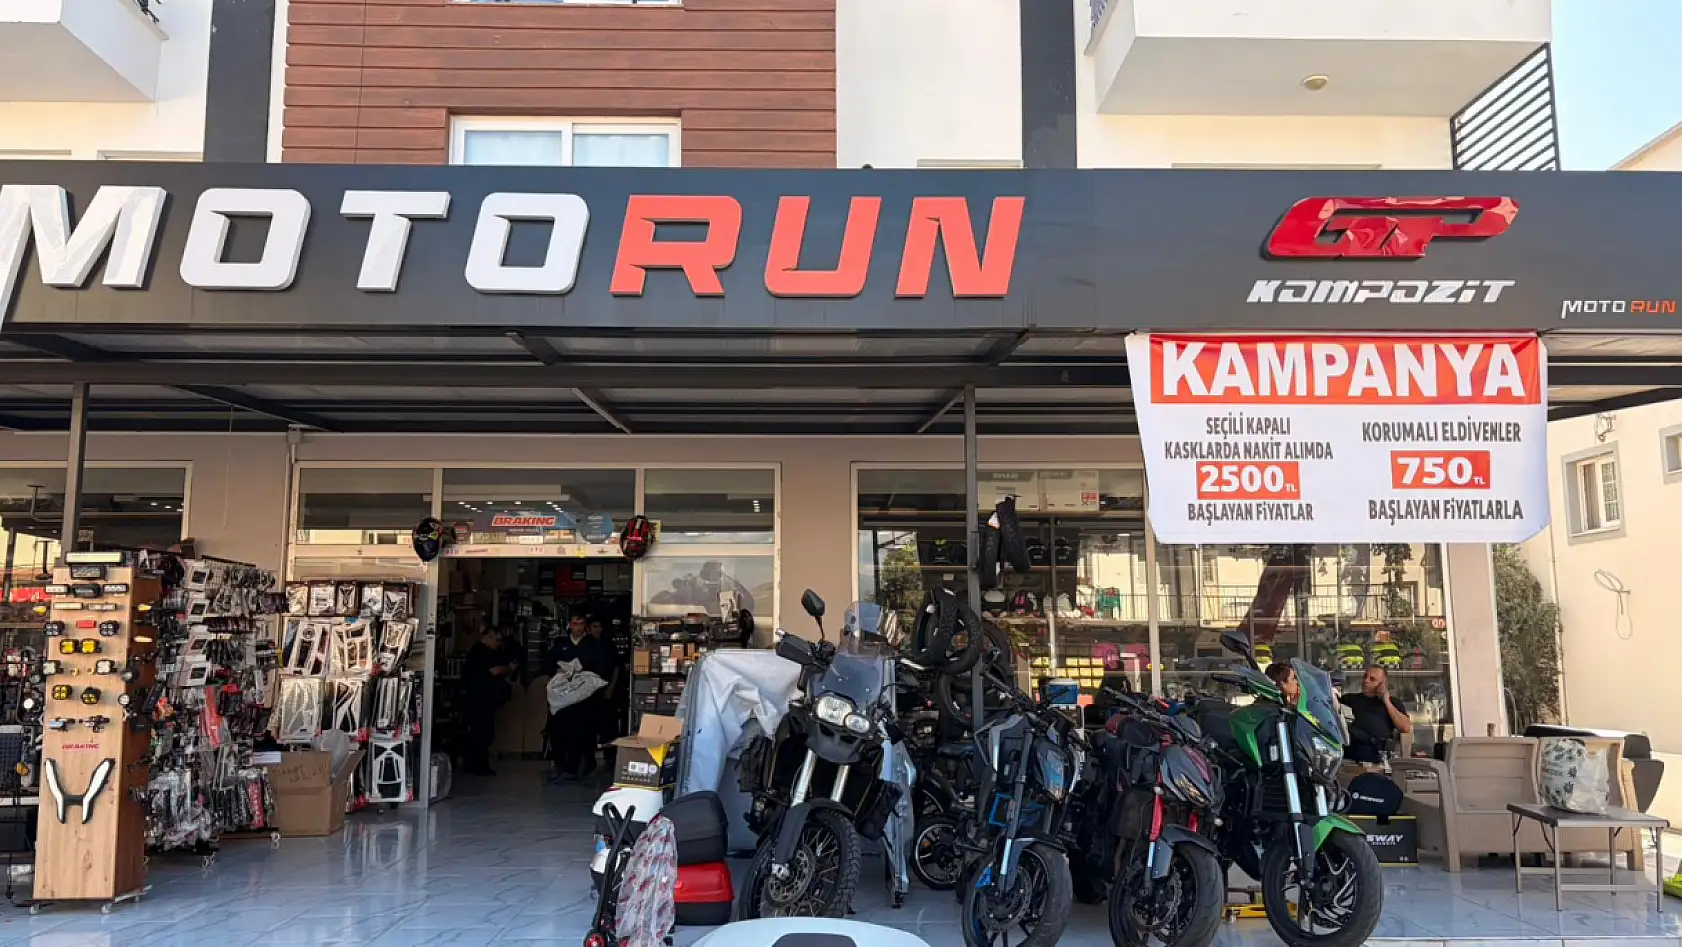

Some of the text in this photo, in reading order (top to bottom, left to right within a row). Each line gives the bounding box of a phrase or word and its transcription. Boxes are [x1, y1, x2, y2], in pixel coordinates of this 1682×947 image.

[1162, 342, 1526, 397] KAMPANYA
[1206, 412, 1291, 439] SEÇİLİ KAPALI
[1362, 416, 1522, 442] KORUMALI ELDİVENLER
[1164, 438, 1334, 459] KASKLARDA NAKİT ALIMDA
[495, 517, 554, 525] BRAKING
[1188, 503, 1253, 526] BAŞLAYAN
[1369, 499, 1440, 526] BAŞLAYAN
